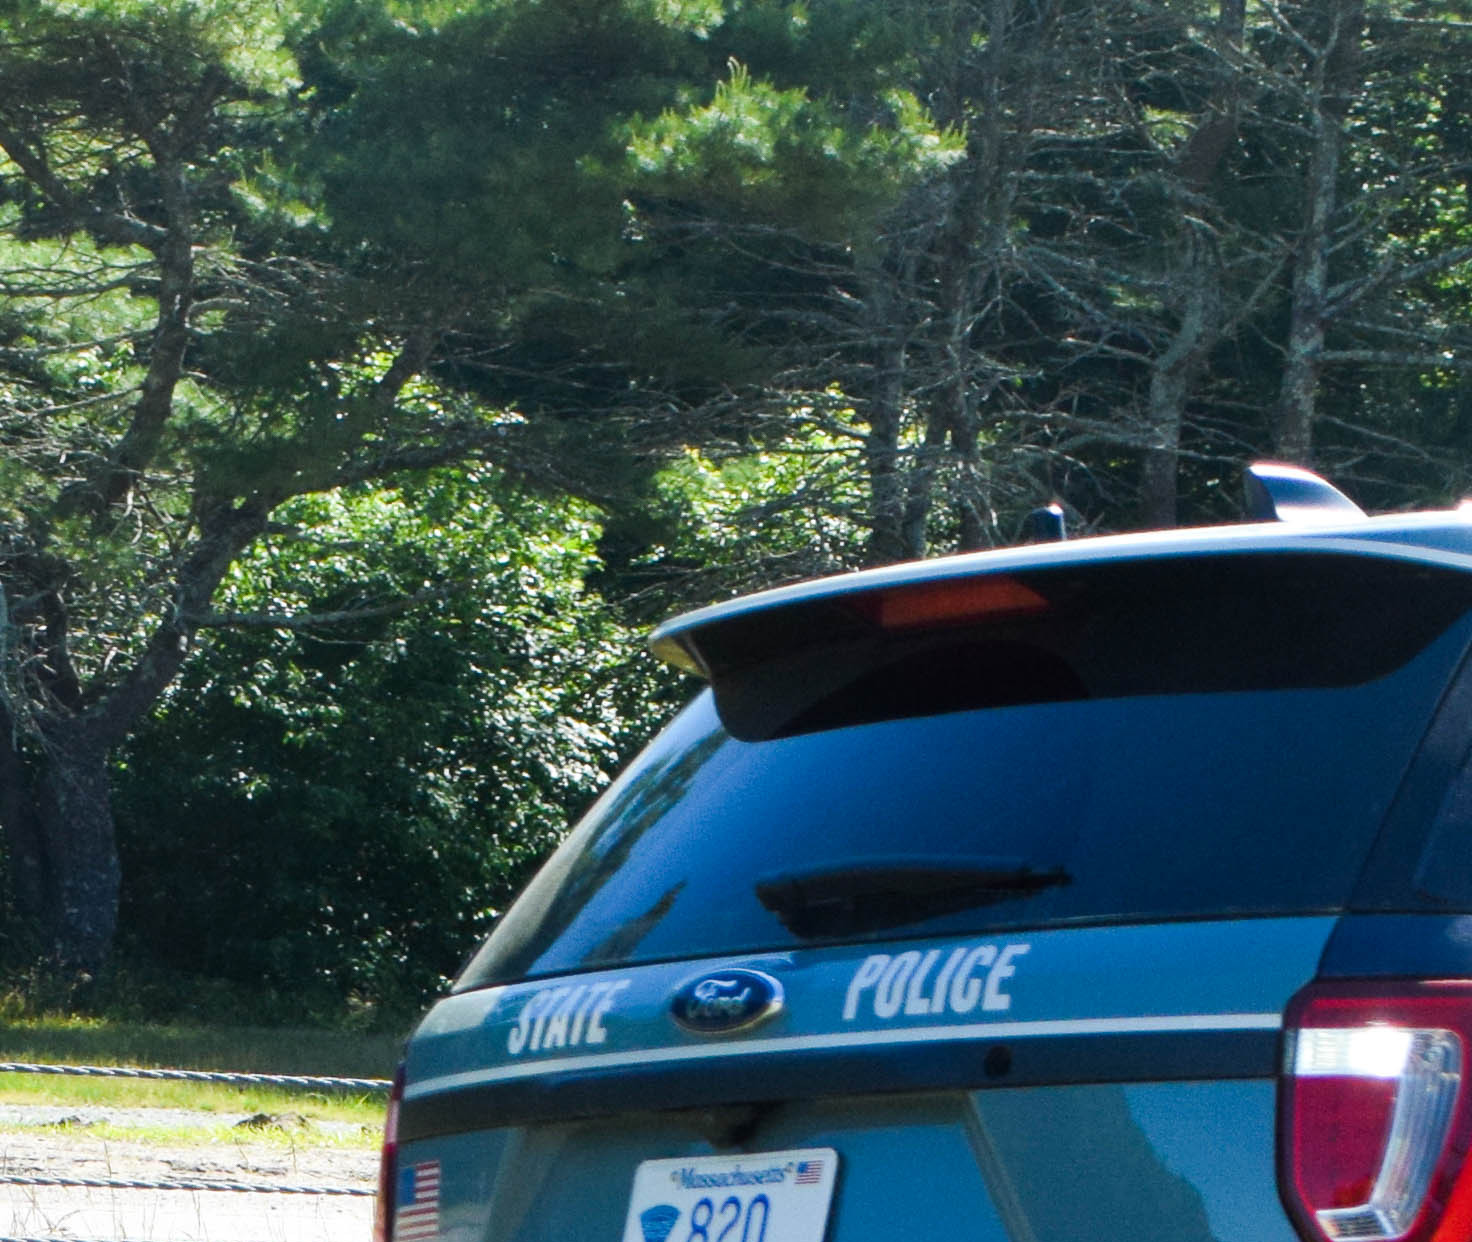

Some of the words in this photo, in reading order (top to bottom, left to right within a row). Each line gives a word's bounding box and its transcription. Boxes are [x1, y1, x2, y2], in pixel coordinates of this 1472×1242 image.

[507, 979, 632, 1055] STATE
[842, 944, 1032, 1020] POLICE
[687, 979, 752, 1017] Ford
[681, 1164, 785, 1189] Massachusetts
